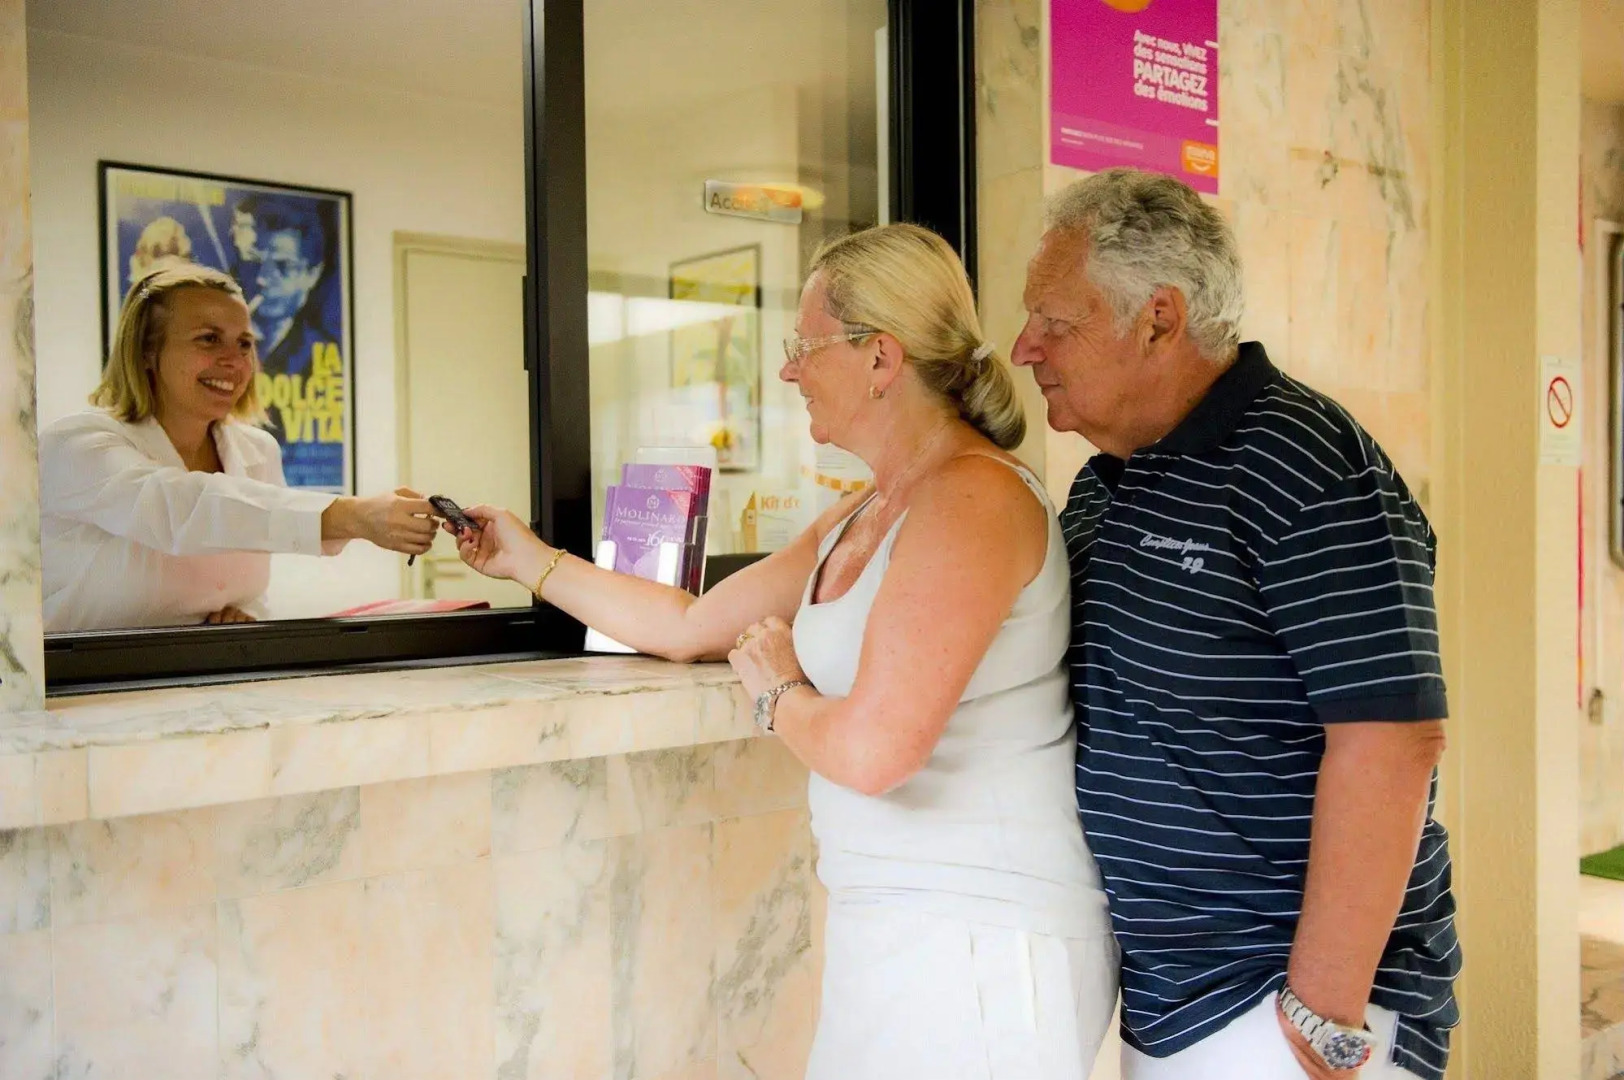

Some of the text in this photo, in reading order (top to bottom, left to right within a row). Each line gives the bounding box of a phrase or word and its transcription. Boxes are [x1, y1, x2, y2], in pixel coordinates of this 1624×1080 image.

[1133, 59, 1209, 96] PARTAGEZ
[1133, 79, 1156, 99] des
[313, 342, 342, 372] LA
[258, 373, 344, 411] DOLCE
[281, 408, 344, 443] VITA
